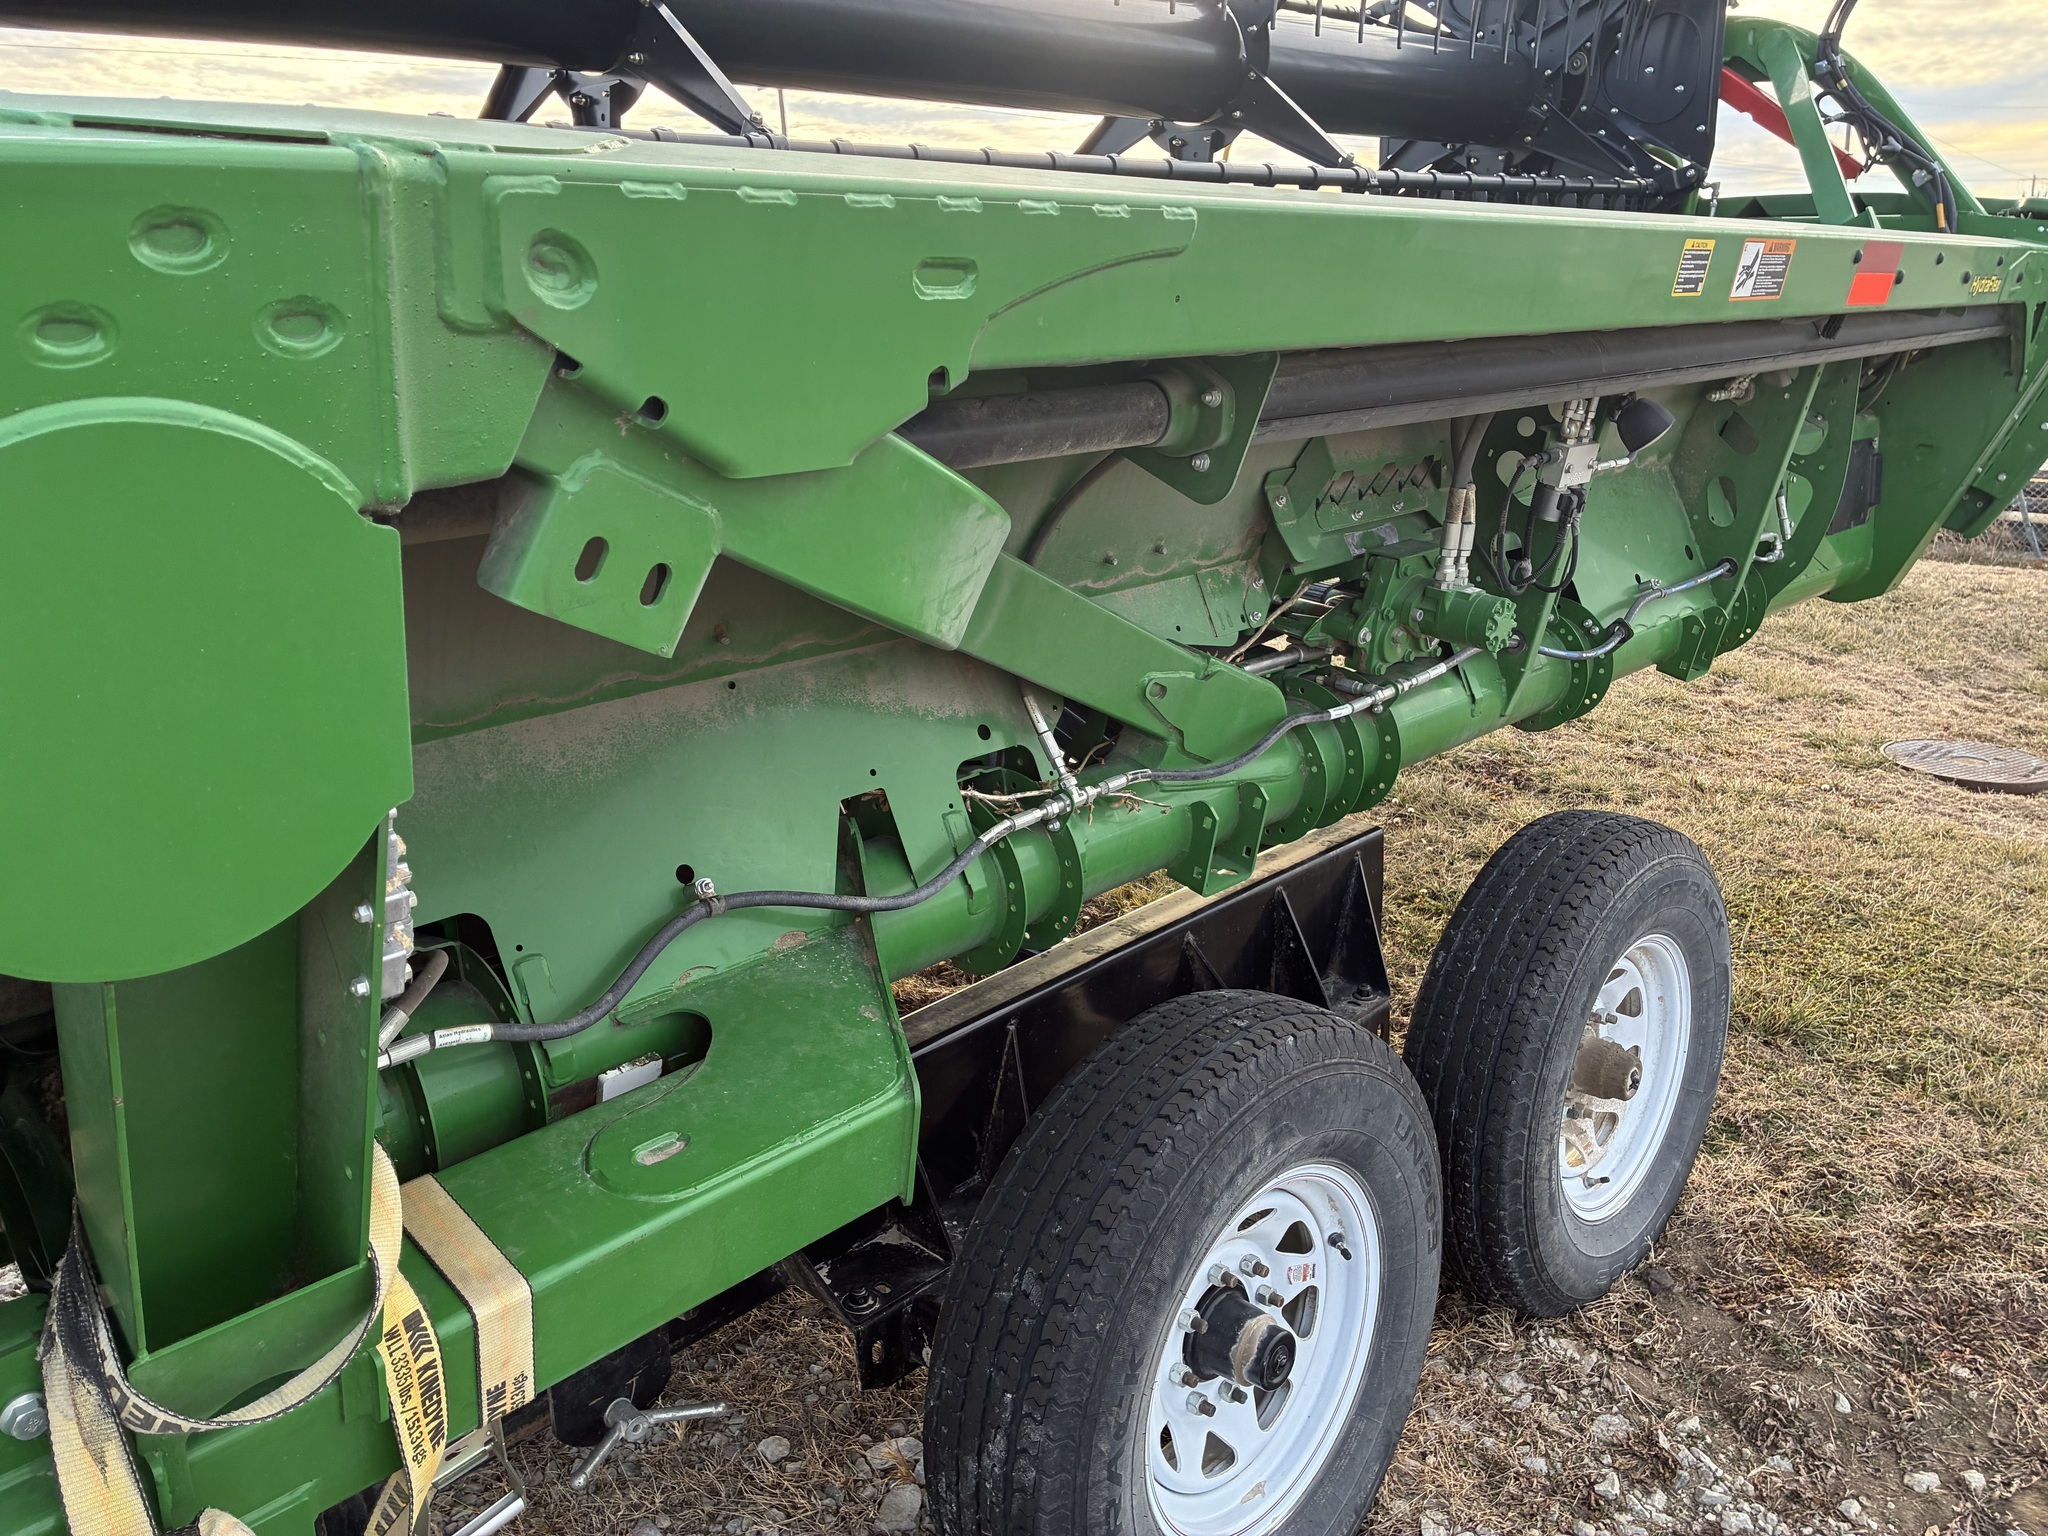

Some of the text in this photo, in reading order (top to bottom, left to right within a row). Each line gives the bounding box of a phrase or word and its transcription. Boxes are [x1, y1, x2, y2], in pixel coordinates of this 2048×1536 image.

[1393, 1112, 1438, 1256] UN203
[384, 1323, 401, 1357] WLL
[416, 1357, 446, 1454] KINEDYNE
